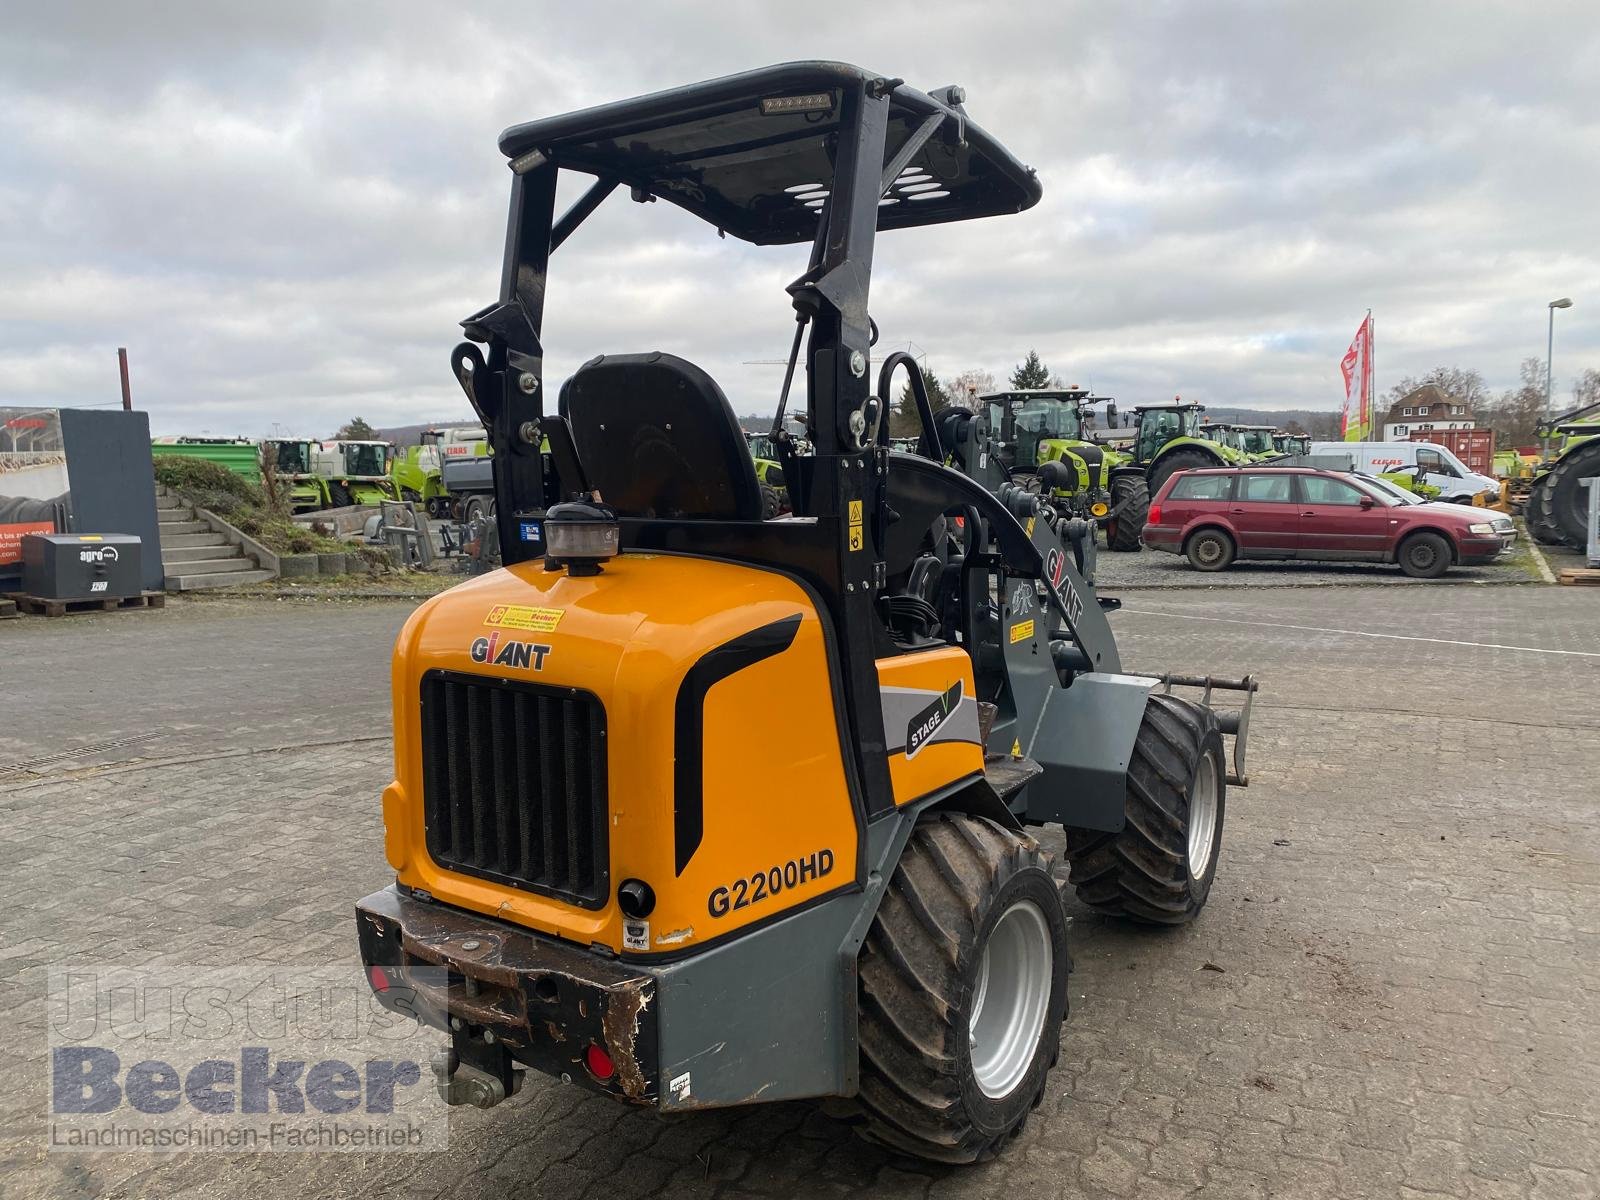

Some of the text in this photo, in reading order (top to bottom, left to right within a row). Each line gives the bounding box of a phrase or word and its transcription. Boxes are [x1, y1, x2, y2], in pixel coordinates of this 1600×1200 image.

[80, 550, 103, 563] agro
[911, 710, 941, 747] STAGE
[707, 848, 835, 919] G2200HD
